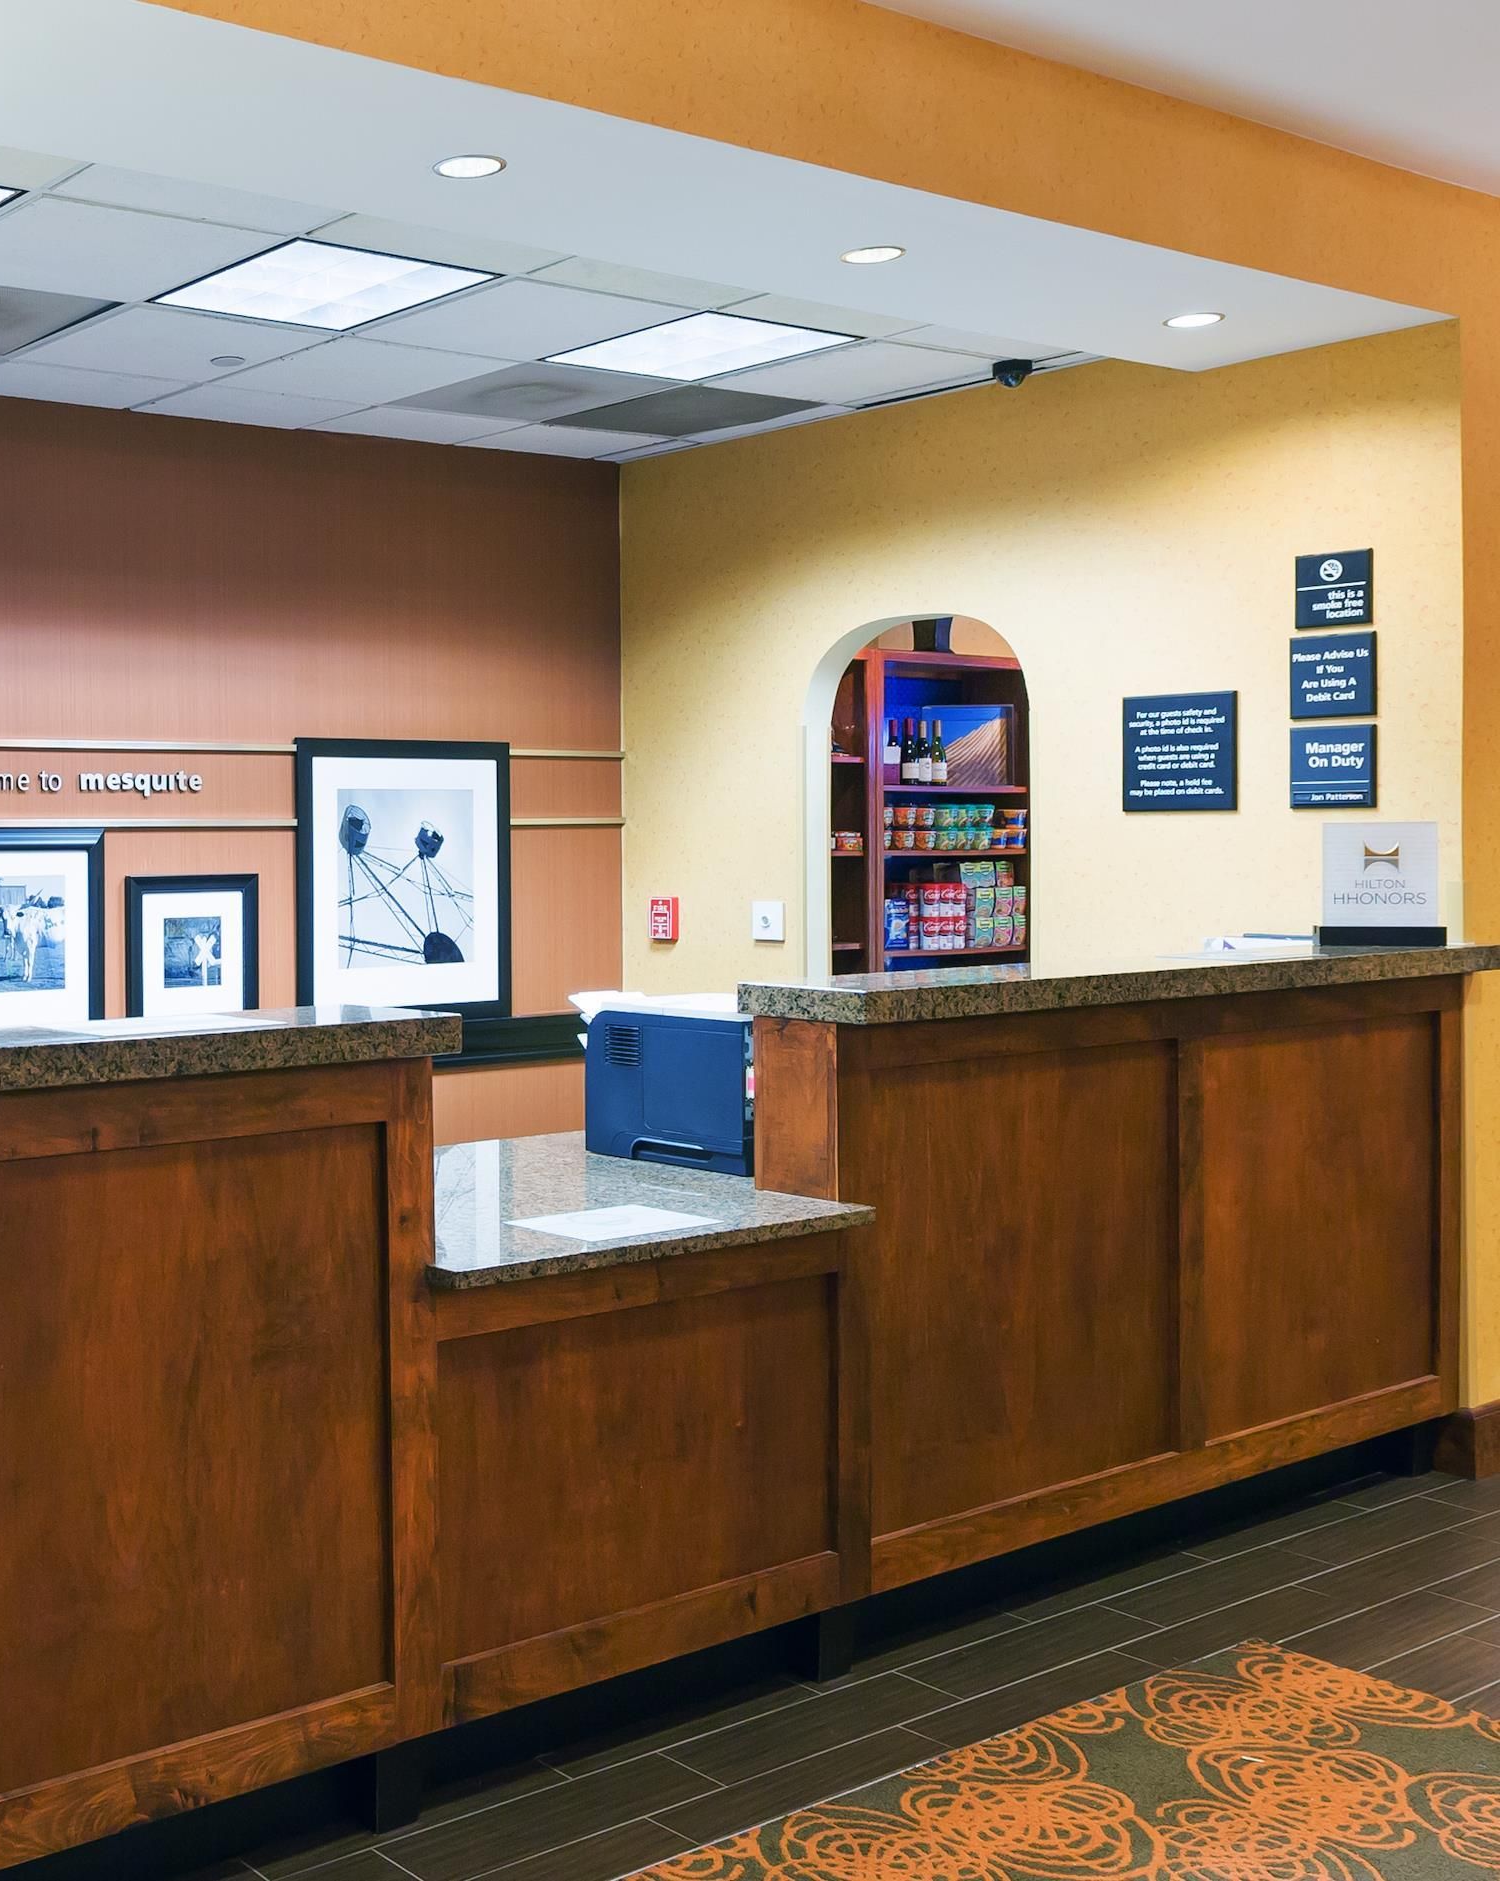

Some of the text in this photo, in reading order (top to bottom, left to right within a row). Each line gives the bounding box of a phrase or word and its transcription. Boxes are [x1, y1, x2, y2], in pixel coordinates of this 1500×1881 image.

[1328, 590, 1345, 600] this
[1347, 589, 1355, 598] is
[1312, 599, 1363, 611] smoke free
[1326, 608, 1363, 619] location
[1292, 648, 1369, 662] Please Advise Us
[1316, 665, 1344, 674] If You
[1301, 678, 1356, 689] Are Using A
[1306, 691, 1355, 702] Debit Card
[1161, 719, 1181, 727] photo
[1141, 745, 1161, 753] photo
[1306, 742, 1364, 756] Manager
[1308, 756, 1364, 769] On Duty
[39, 770, 62, 792] to
[79, 770, 203, 799] mesquite
[1355, 879, 1405, 889] HILTON
[1333, 892, 1427, 905] HHONORS
